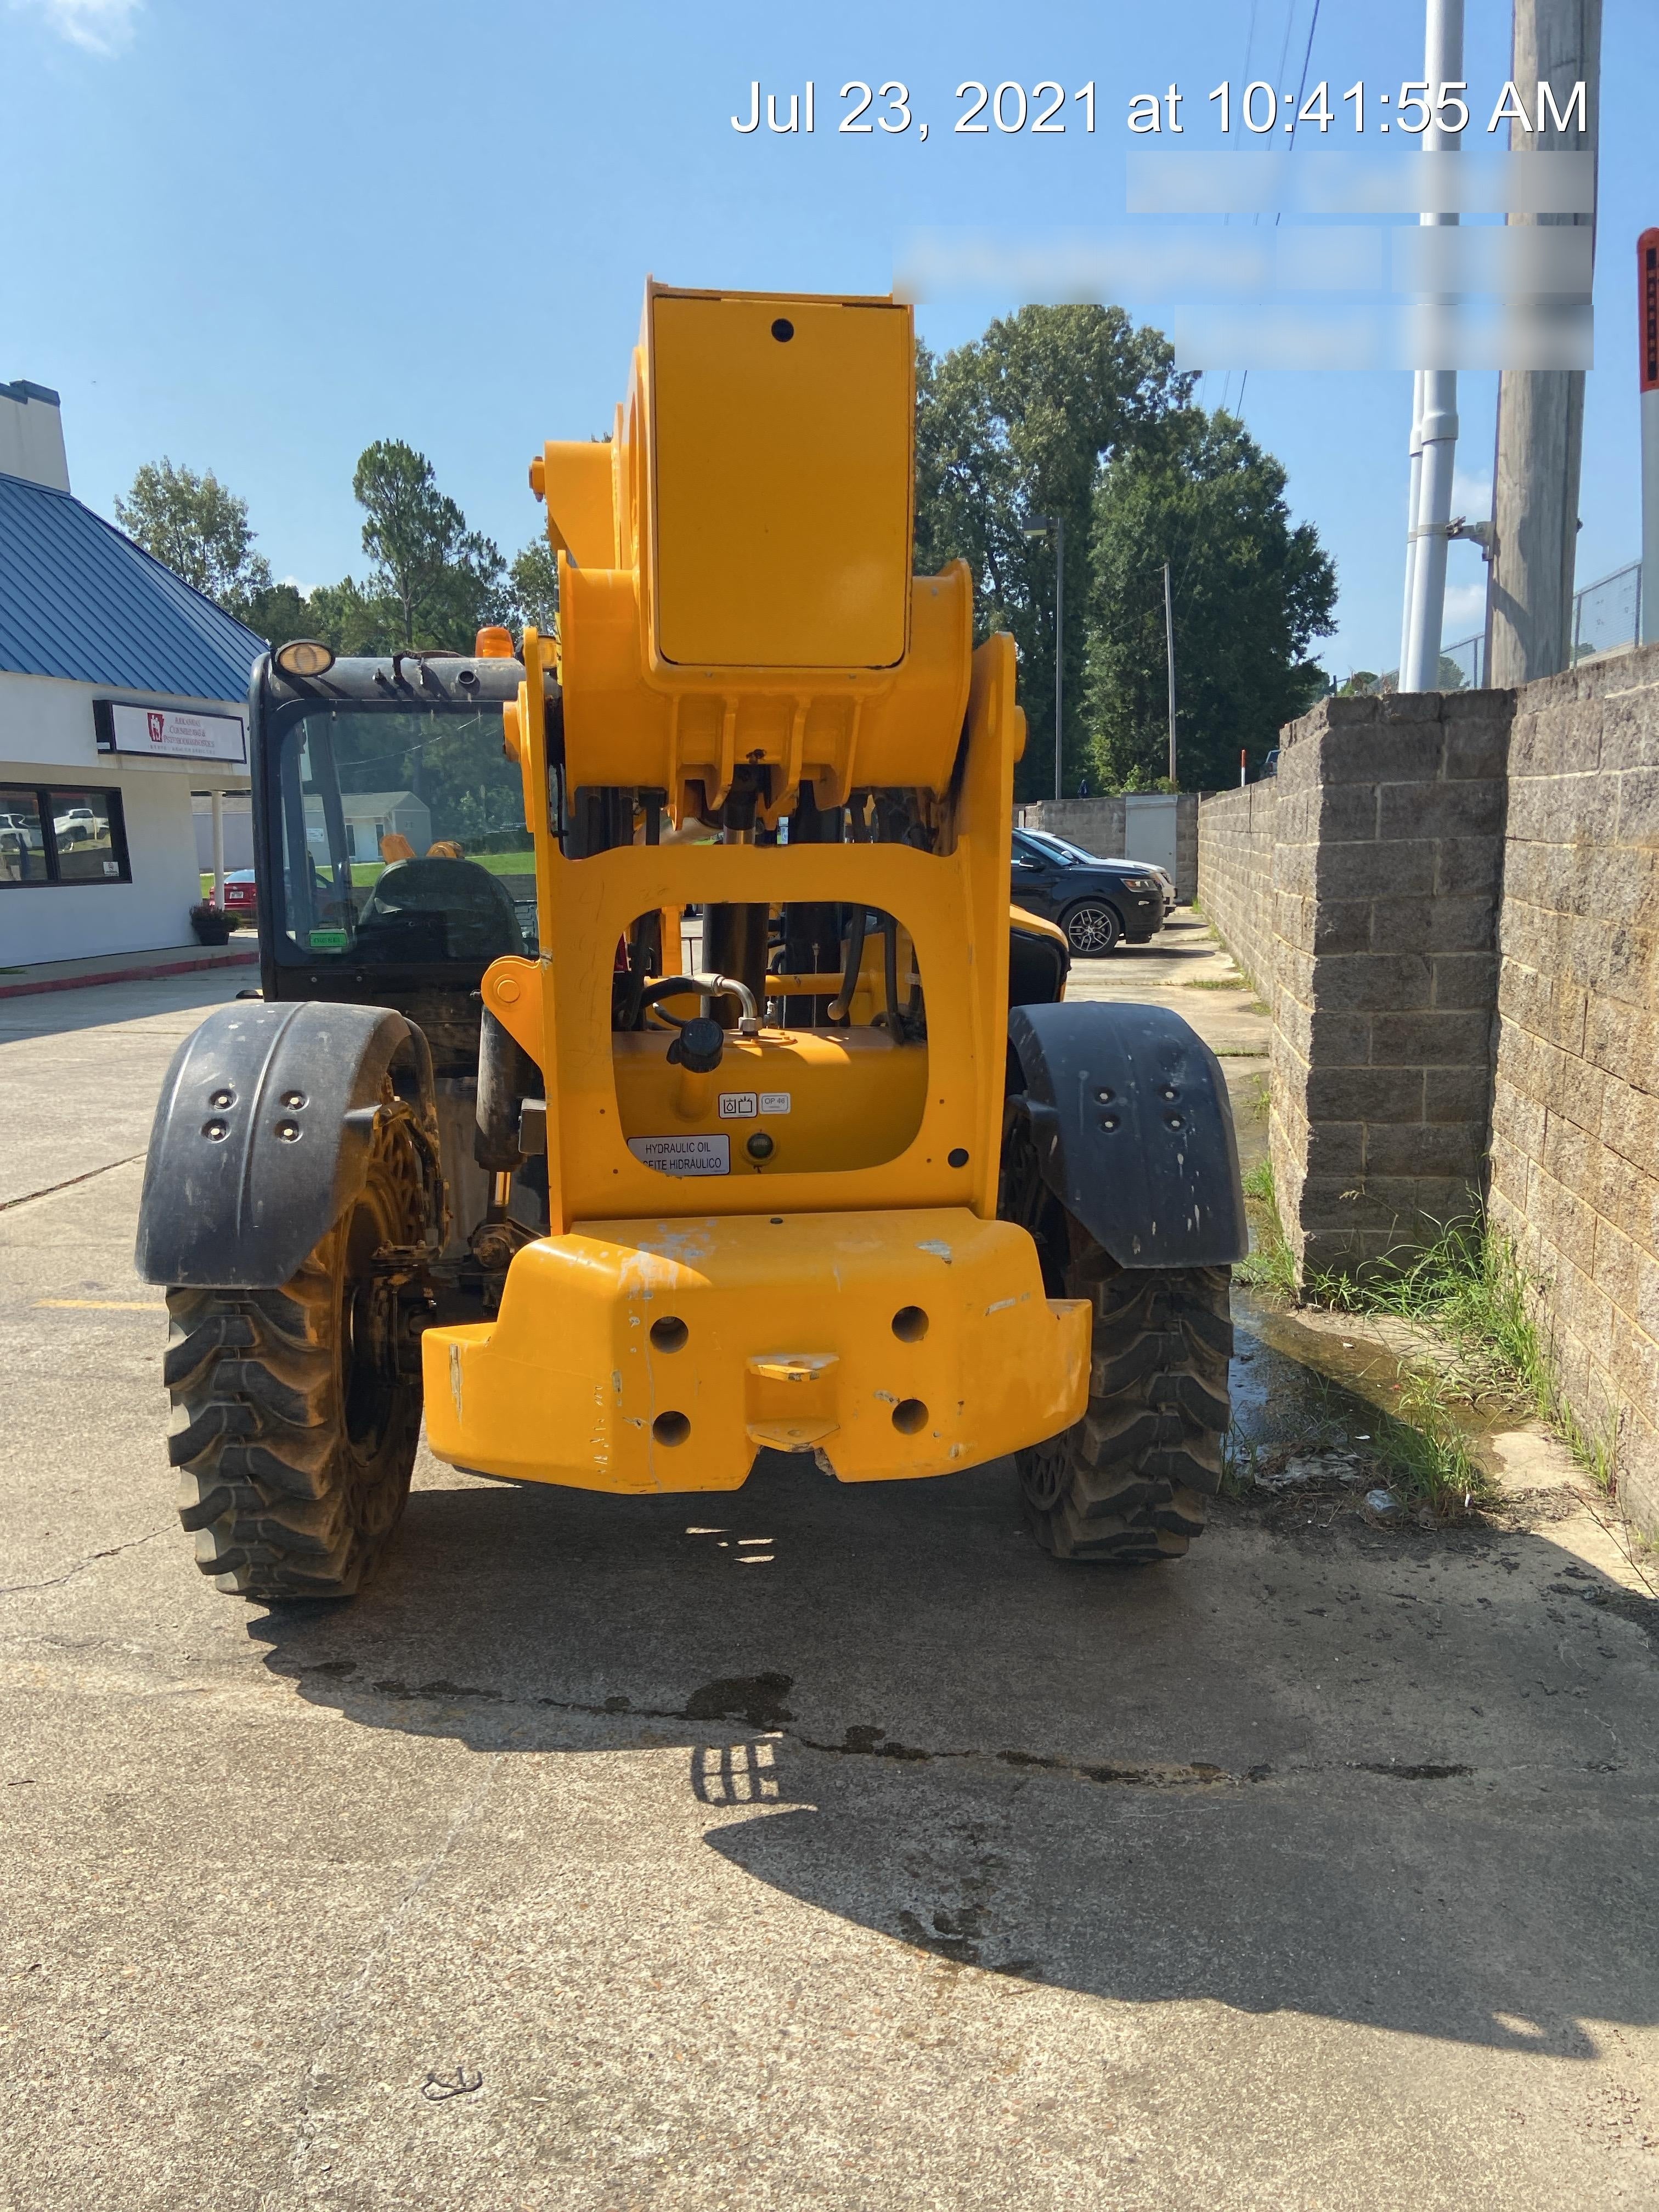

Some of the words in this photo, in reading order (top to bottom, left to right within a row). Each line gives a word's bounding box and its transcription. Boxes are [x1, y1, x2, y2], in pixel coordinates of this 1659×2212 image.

[646, 1142, 695, 1154] HYDRAULIC
[697, 1142, 711, 1152] OIL
[643, 1160, 667, 1170] CEITE
